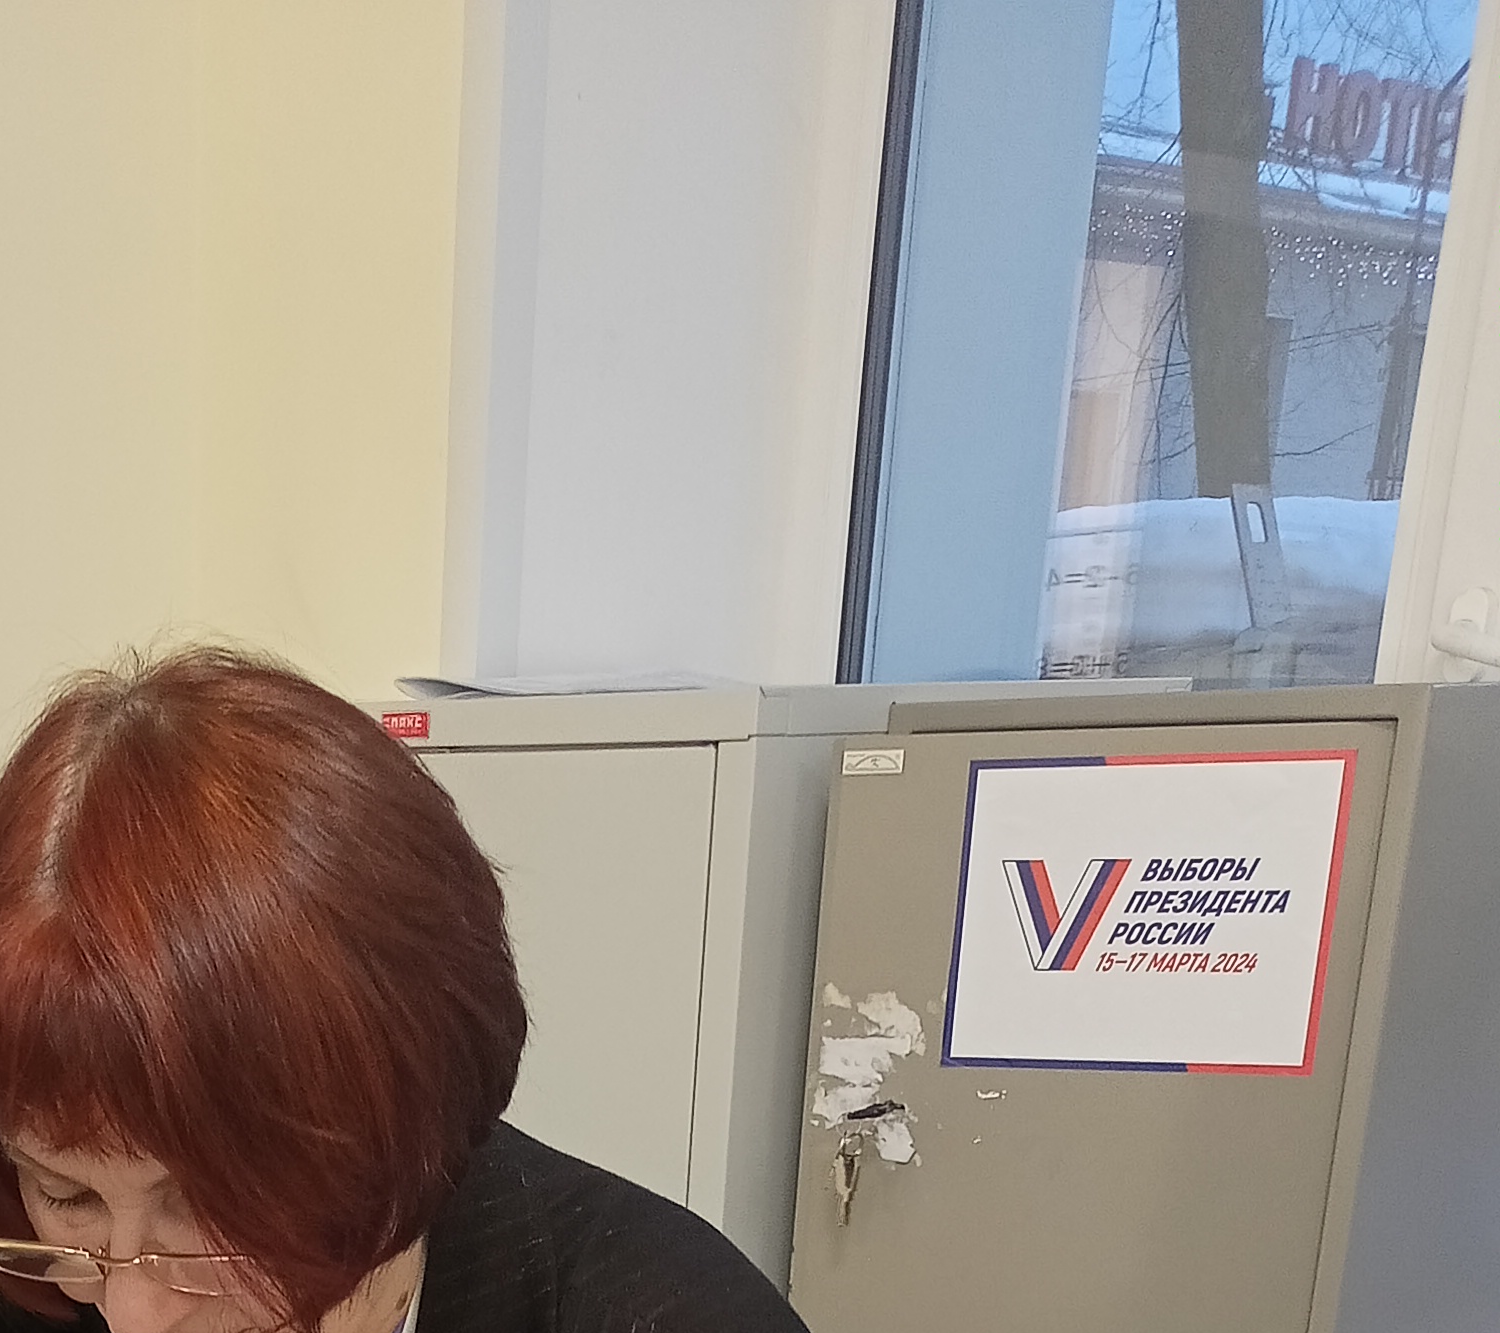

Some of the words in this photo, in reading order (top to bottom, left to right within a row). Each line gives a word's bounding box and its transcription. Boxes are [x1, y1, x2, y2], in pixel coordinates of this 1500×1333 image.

[1140, 857, 1261, 882] ВЫБОРЫ
[1123, 889, 1291, 916] ПРЕЗИДЕНТА
[1107, 922, 1215, 946] РОССИИ
[1148, 953, 1208, 973] МАРТА
[1211, 953, 1259, 974] 2024
